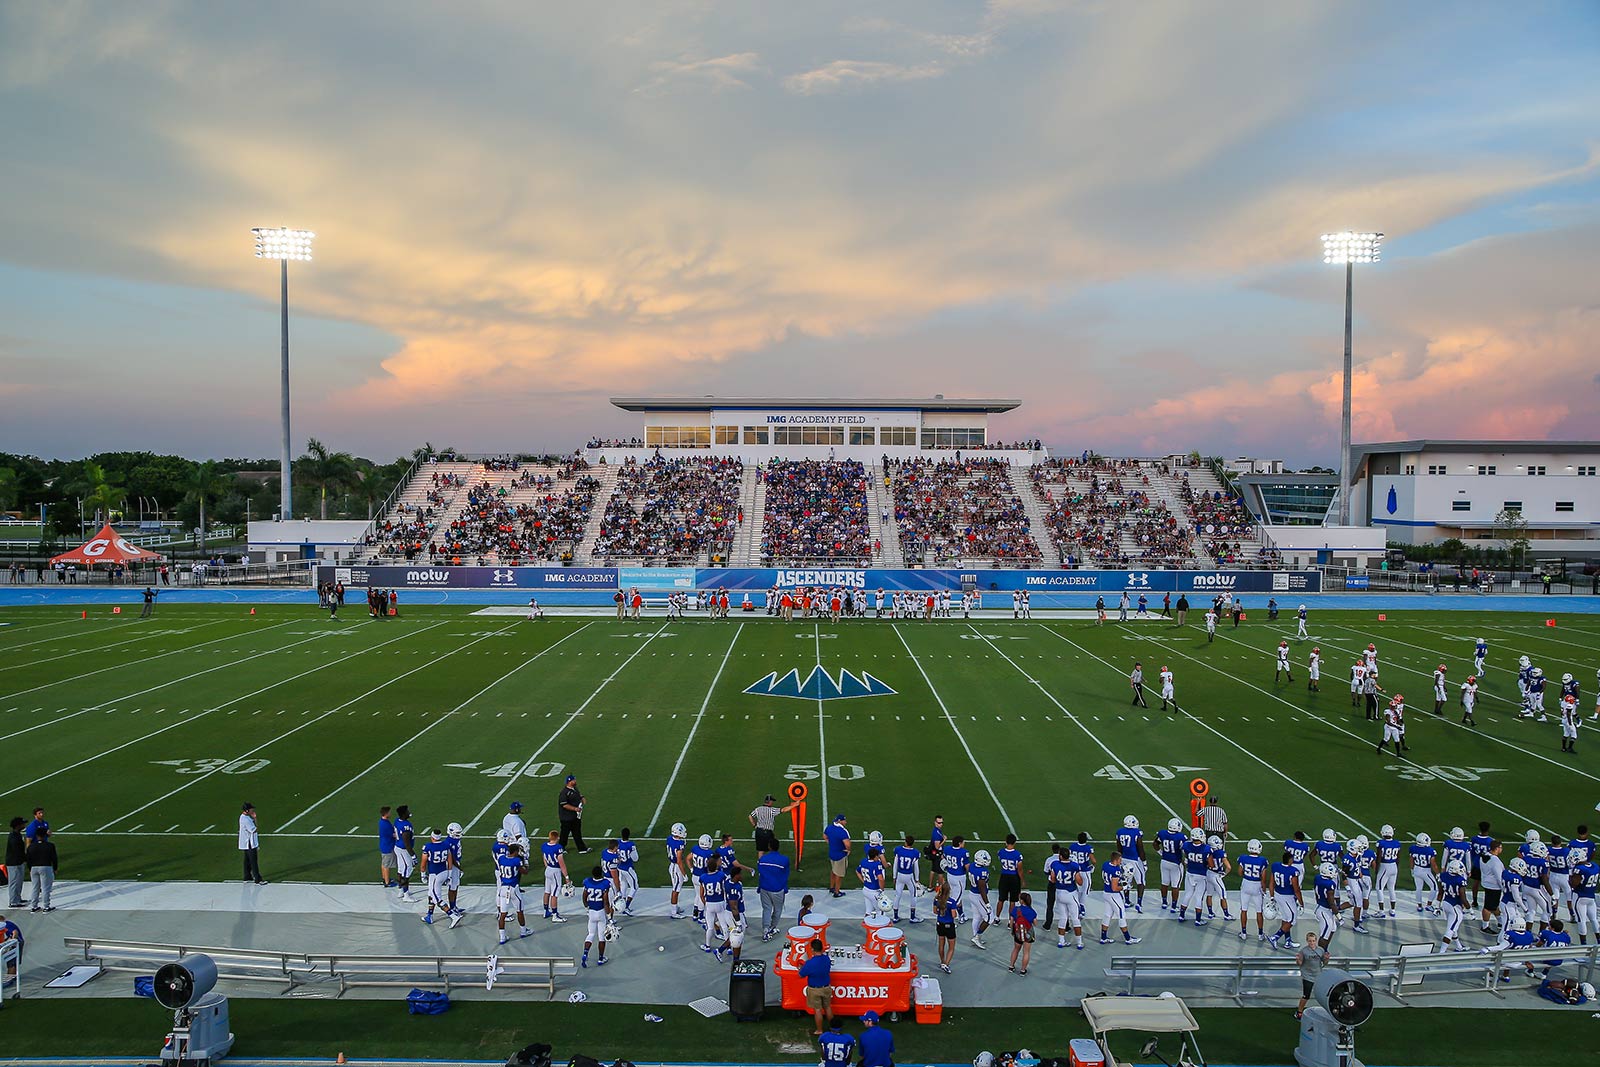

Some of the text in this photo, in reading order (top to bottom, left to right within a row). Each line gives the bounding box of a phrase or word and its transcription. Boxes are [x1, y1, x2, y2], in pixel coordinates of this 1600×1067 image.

[766, 415, 866, 424] IMG ACADEMY FIELD
[83, 539, 110, 556] G
[406, 569, 450, 581] motus
[544, 574, 565, 582] IMG
[567, 574, 615, 583] ACADEMY
[775, 570, 866, 588] ASCENDERS
[1026, 576, 1097, 585] IMG ACADEMY
[1193, 573, 1237, 585] motus
[175, 758, 272, 774] 30
[479, 761, 566, 778] 40
[783, 764, 866, 780] 50
[1093, 764, 1176, 780] 40
[1383, 765, 1481, 781] 30
[433, 849, 448, 863] 56
[692, 854, 704, 869] 50
[1319, 850, 1336, 863] 23
[1412, 853, 1428, 867] 38
[1549, 855, 1566, 869] 59
[899, 857, 911, 870] 17
[1000, 858, 1016, 871] 35
[1244, 863, 1260, 878] 55
[500, 865, 513, 879] 10
[1056, 871, 1072, 884] 42
[1274, 873, 1285, 888] 61
[587, 888, 603, 901] 22
[706, 881, 722, 896] 84
[795, 943, 806, 954] G
[884, 944, 895, 955] G
[802, 986, 889, 999] TORADE
[826, 1042, 845, 1062] 15
